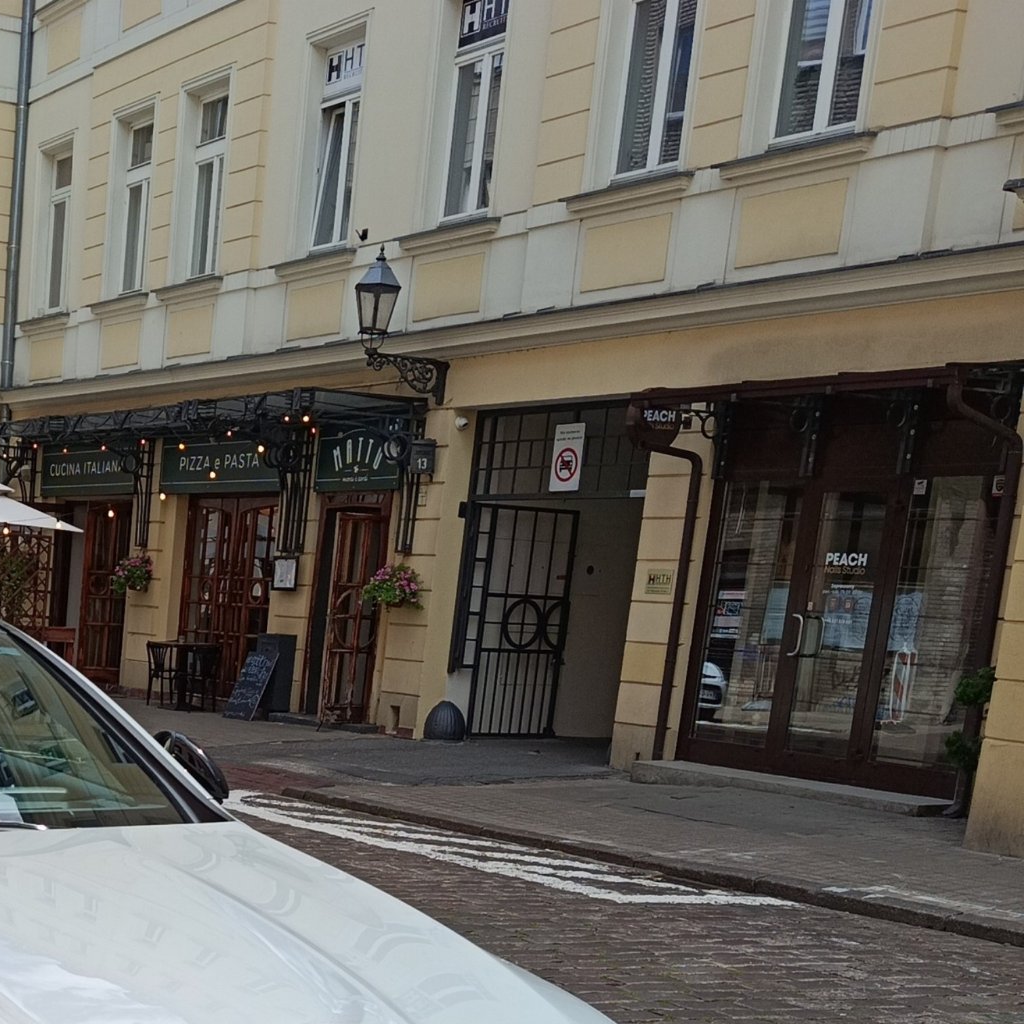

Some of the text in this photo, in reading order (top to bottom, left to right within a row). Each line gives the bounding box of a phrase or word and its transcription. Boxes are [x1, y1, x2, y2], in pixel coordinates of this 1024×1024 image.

[49, 462, 81, 477] CUCINA
[179, 453, 259, 472] PIZZA e PASTA
[416, 457, 428, 470] 13
[825, 552, 868, 567] PEACH
[842, 565, 866, 575] Studio
